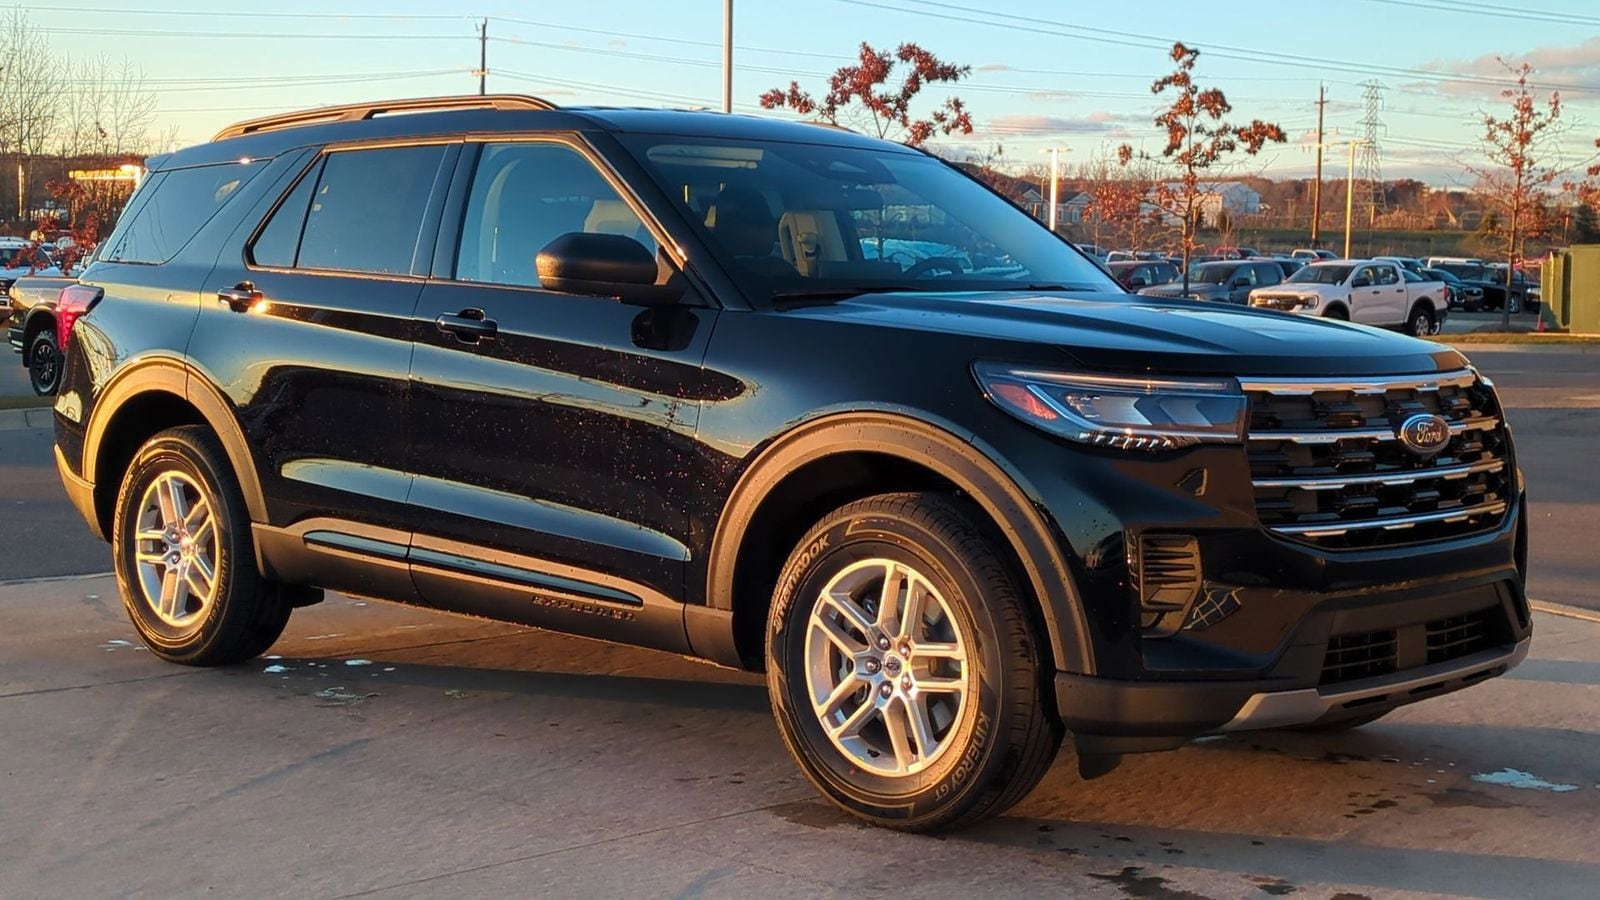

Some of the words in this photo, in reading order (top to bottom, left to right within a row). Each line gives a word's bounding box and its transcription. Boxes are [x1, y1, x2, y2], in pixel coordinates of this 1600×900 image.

[1416, 421, 1442, 443] Ford
[951, 711, 991, 791] KINERGY
[935, 785, 949, 801] GT
